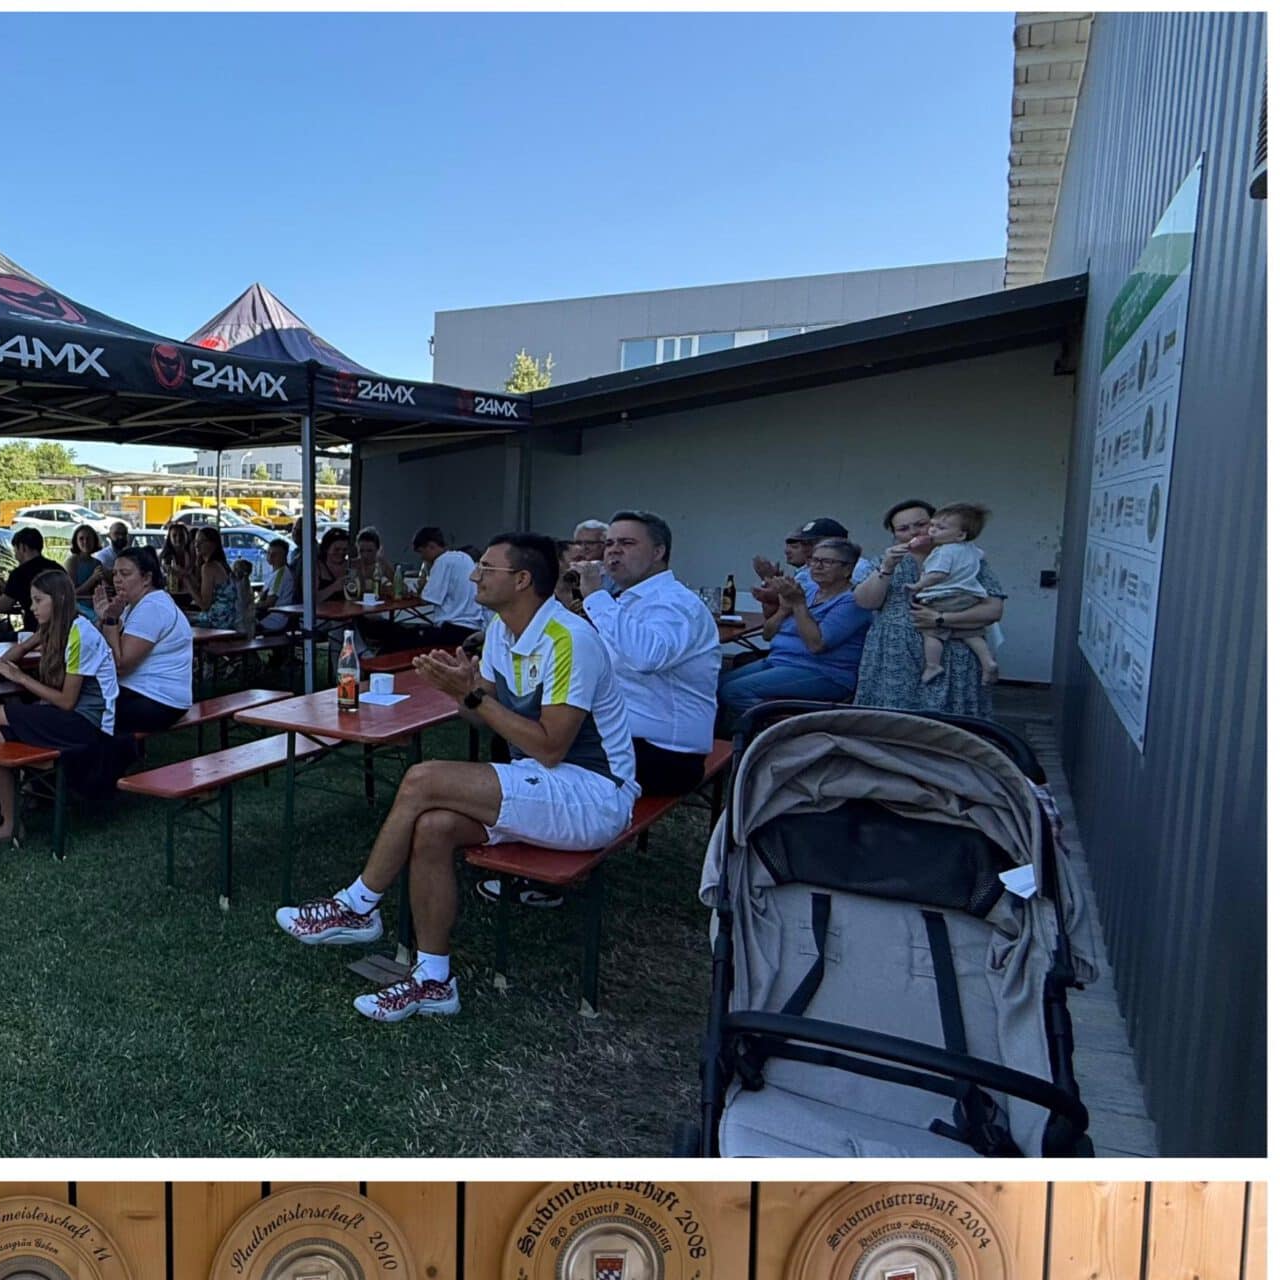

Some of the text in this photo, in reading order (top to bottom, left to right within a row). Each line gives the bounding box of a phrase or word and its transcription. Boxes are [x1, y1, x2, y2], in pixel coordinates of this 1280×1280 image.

[191, 359, 288, 401] 24MX
[357, 380, 416, 405] 24MX
[475, 397, 519, 418] 24MX
[230, 1203, 398, 1273] Stadtmeisterschaft 2010
[675, 1210, 707, 1259] 2008
[957, 1210, 991, 1249] 2004
